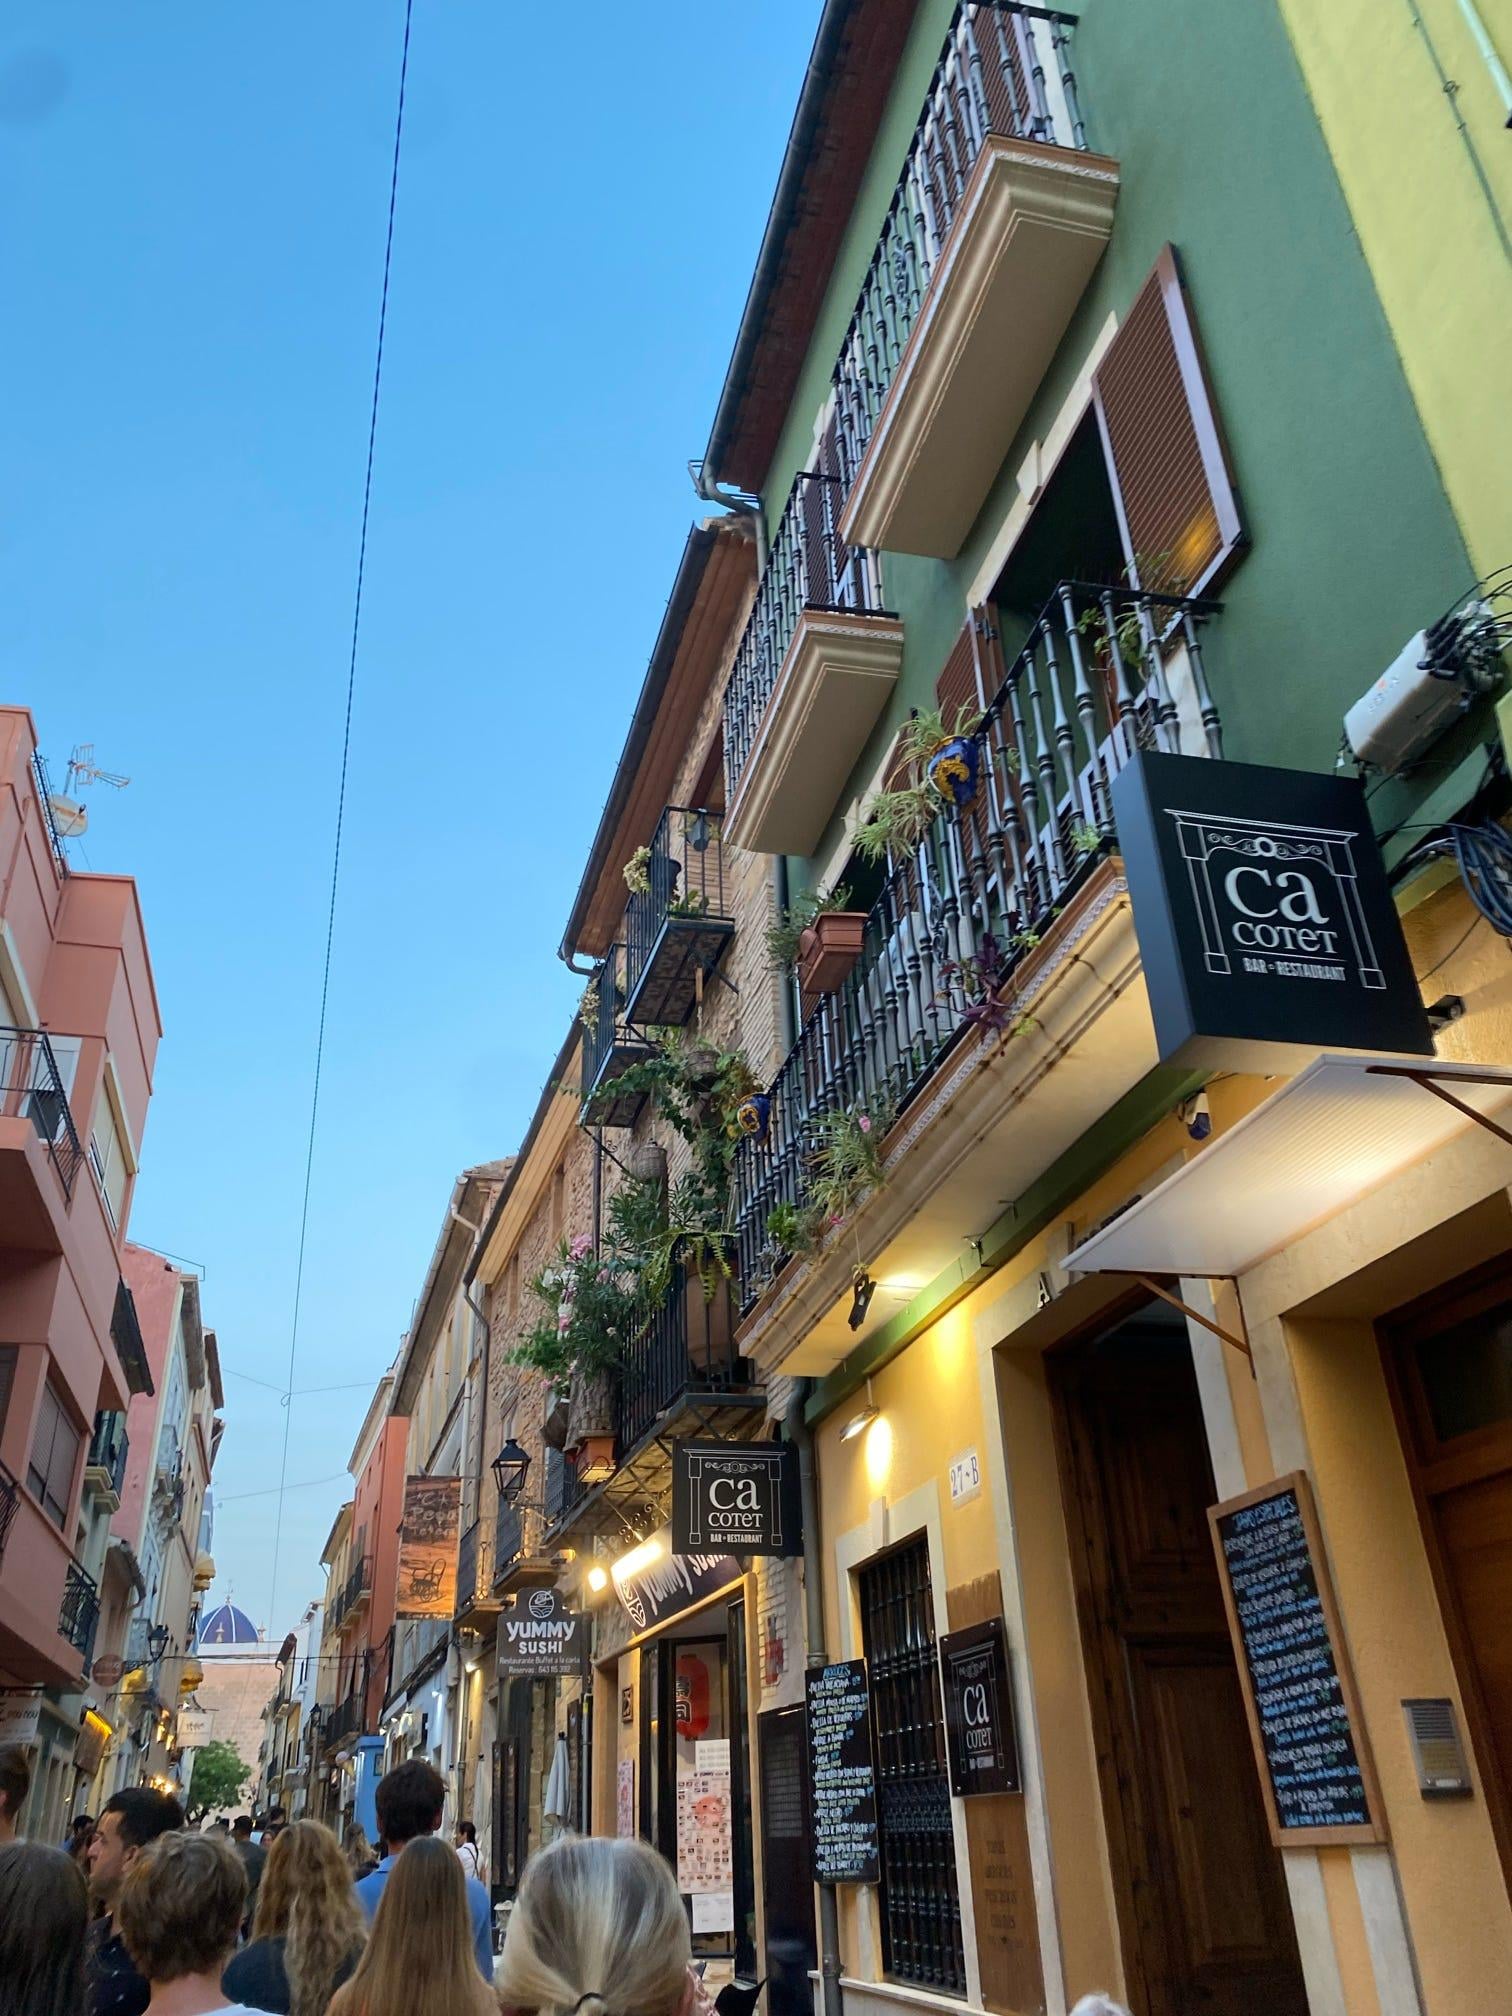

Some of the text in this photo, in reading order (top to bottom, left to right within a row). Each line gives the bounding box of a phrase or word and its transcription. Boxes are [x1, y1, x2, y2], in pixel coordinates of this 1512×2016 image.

[1242, 957, 1346, 982] BAR RESTAURANT
[710, 1533, 763, 1544] BAR RESTAURANT
[518, 1641, 563, 1654] SUSHI
